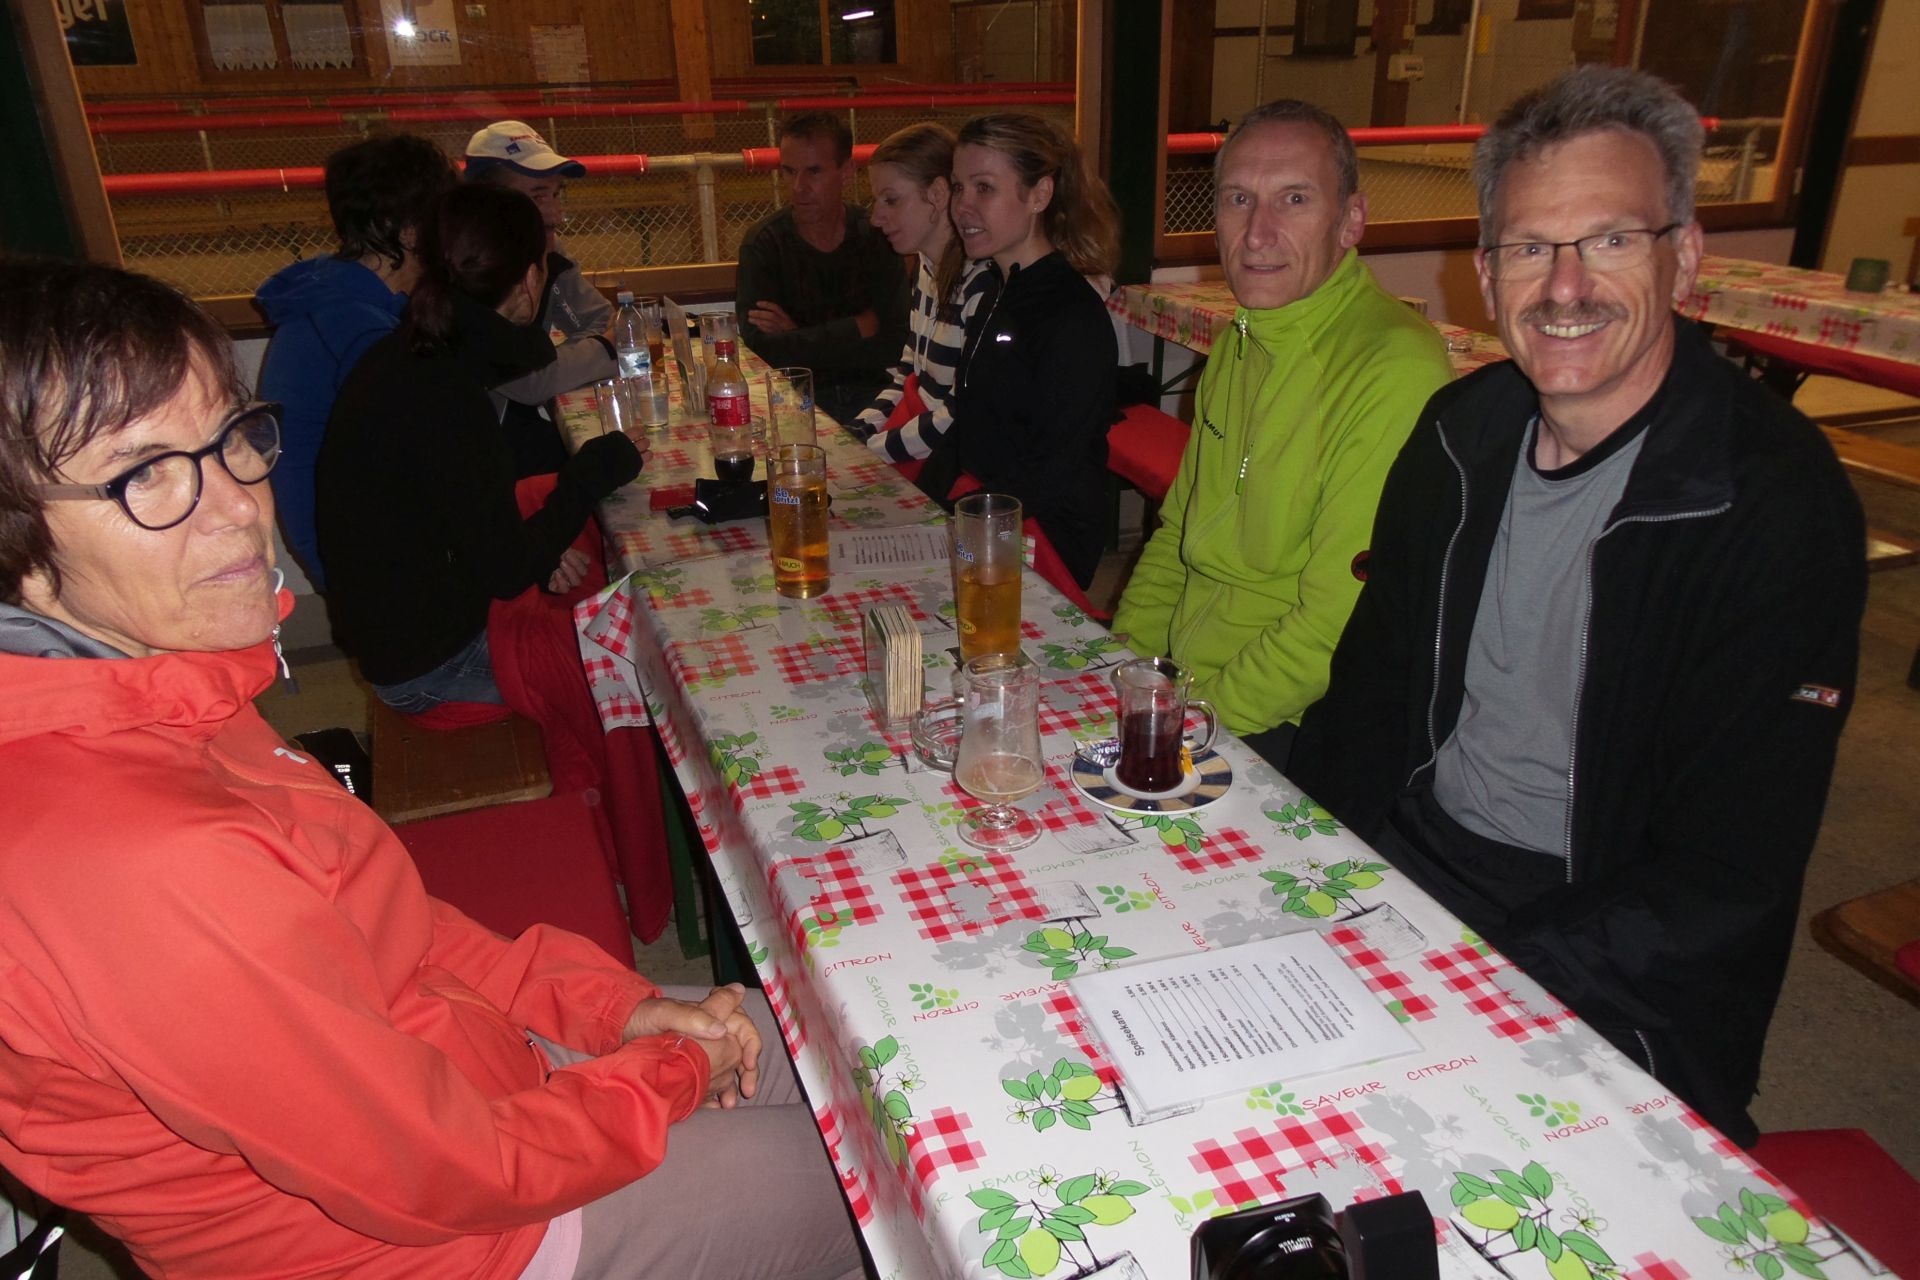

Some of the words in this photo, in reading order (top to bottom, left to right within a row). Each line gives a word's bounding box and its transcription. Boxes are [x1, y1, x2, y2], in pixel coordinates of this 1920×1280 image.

[1028, 857, 1086, 875] LEMON
[1181, 872, 1249, 892] SAVOUR
[1138, 871, 1177, 911] CITRON
[1181, 921, 1212, 953] VEUR
[823, 953, 893, 978] CITRON
[865, 975, 897, 1028] SAVOUR
[912, 1001, 979, 1022] CITRON
[1000, 981, 1071, 1002] SAVEUR
[1111, 1009, 1145, 1056] Speisekarte
[1301, 1080, 1386, 1112] SAVEUR
[1405, 1055, 1479, 1082] CITRON
[1462, 1083, 1531, 1152] SAVOUR
[1542, 1115, 1611, 1144] CITRON
[1625, 1094, 1679, 1116] VEUR
[1128, 1140, 1172, 1199] LEMON
